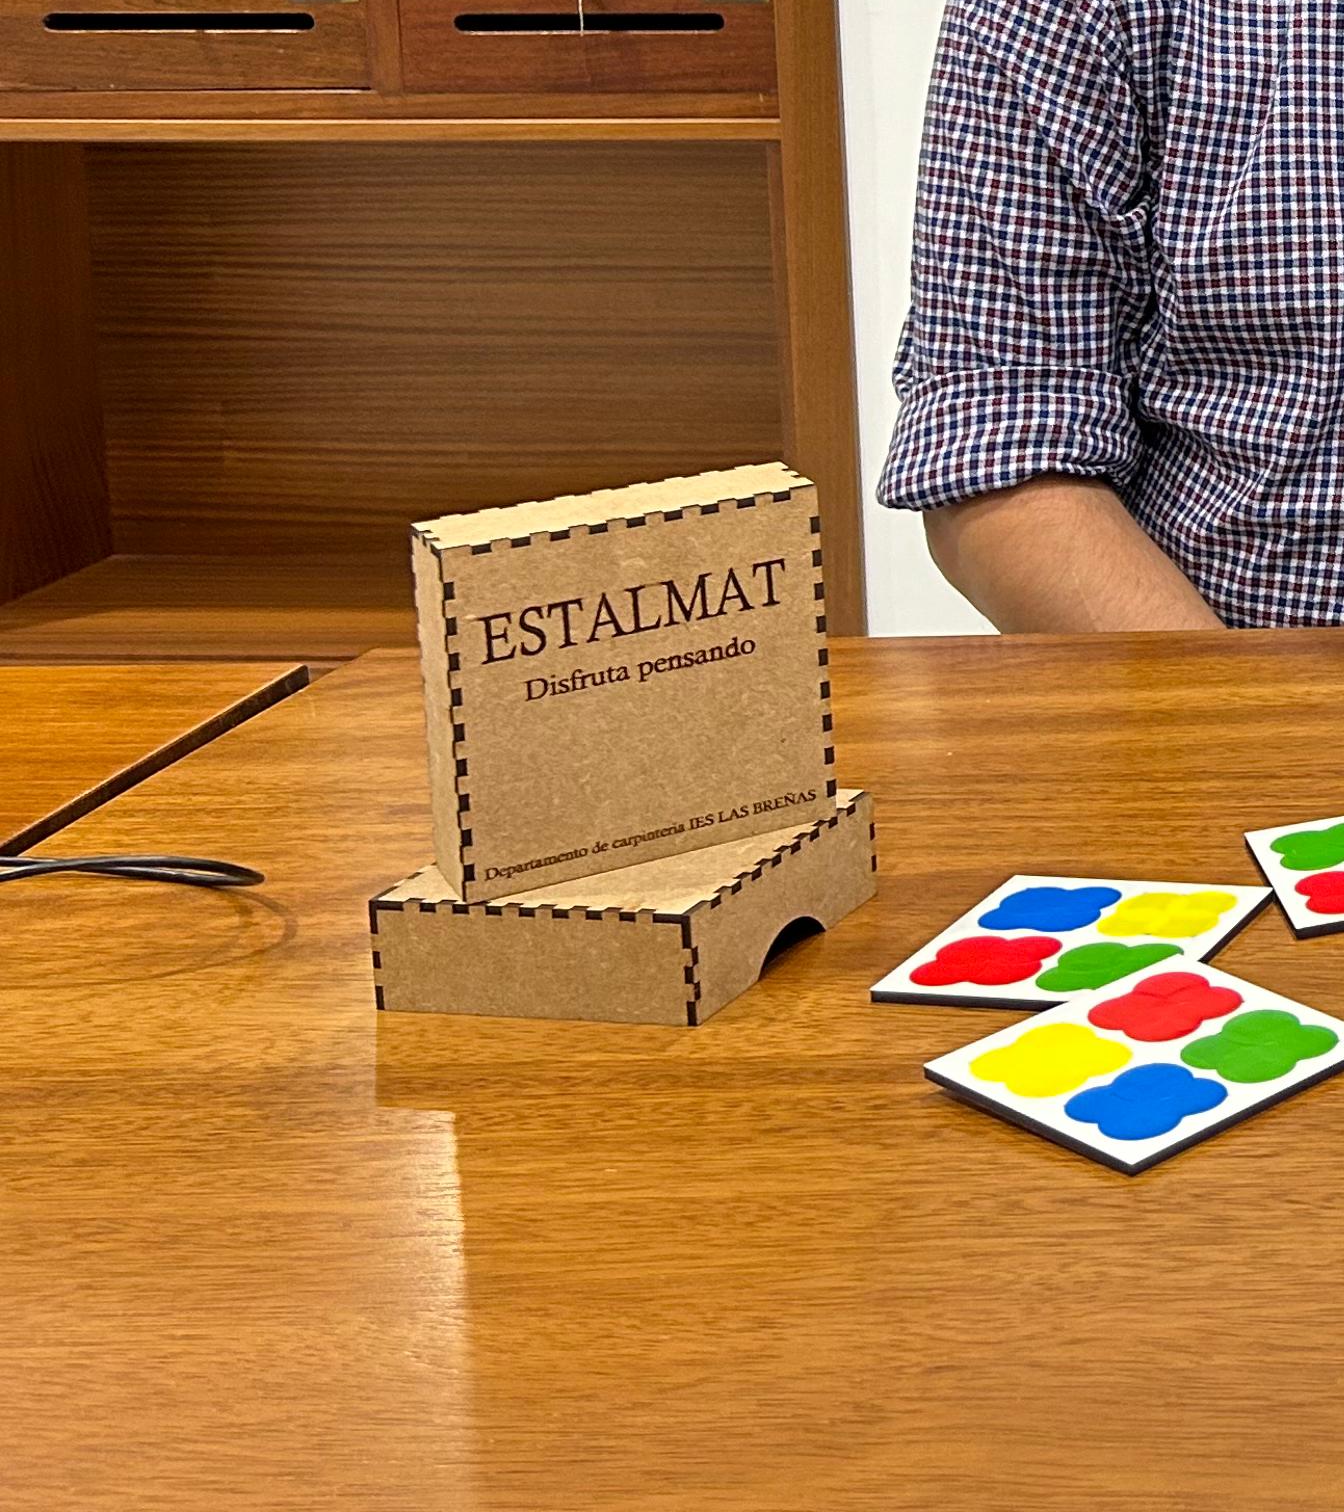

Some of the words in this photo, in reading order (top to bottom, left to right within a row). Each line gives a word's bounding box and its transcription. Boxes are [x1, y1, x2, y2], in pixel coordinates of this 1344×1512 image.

[476, 558, 786, 665] ESTALMAT
[523, 665, 631, 702] Disfruta
[636, 636, 757, 683] pensando
[484, 846, 588, 882] Departamento
[591, 840, 609, 855] de
[689, 813, 714, 831] IES
[718, 804, 749, 824] LAS
[752, 788, 817, 815] BREÑAS
